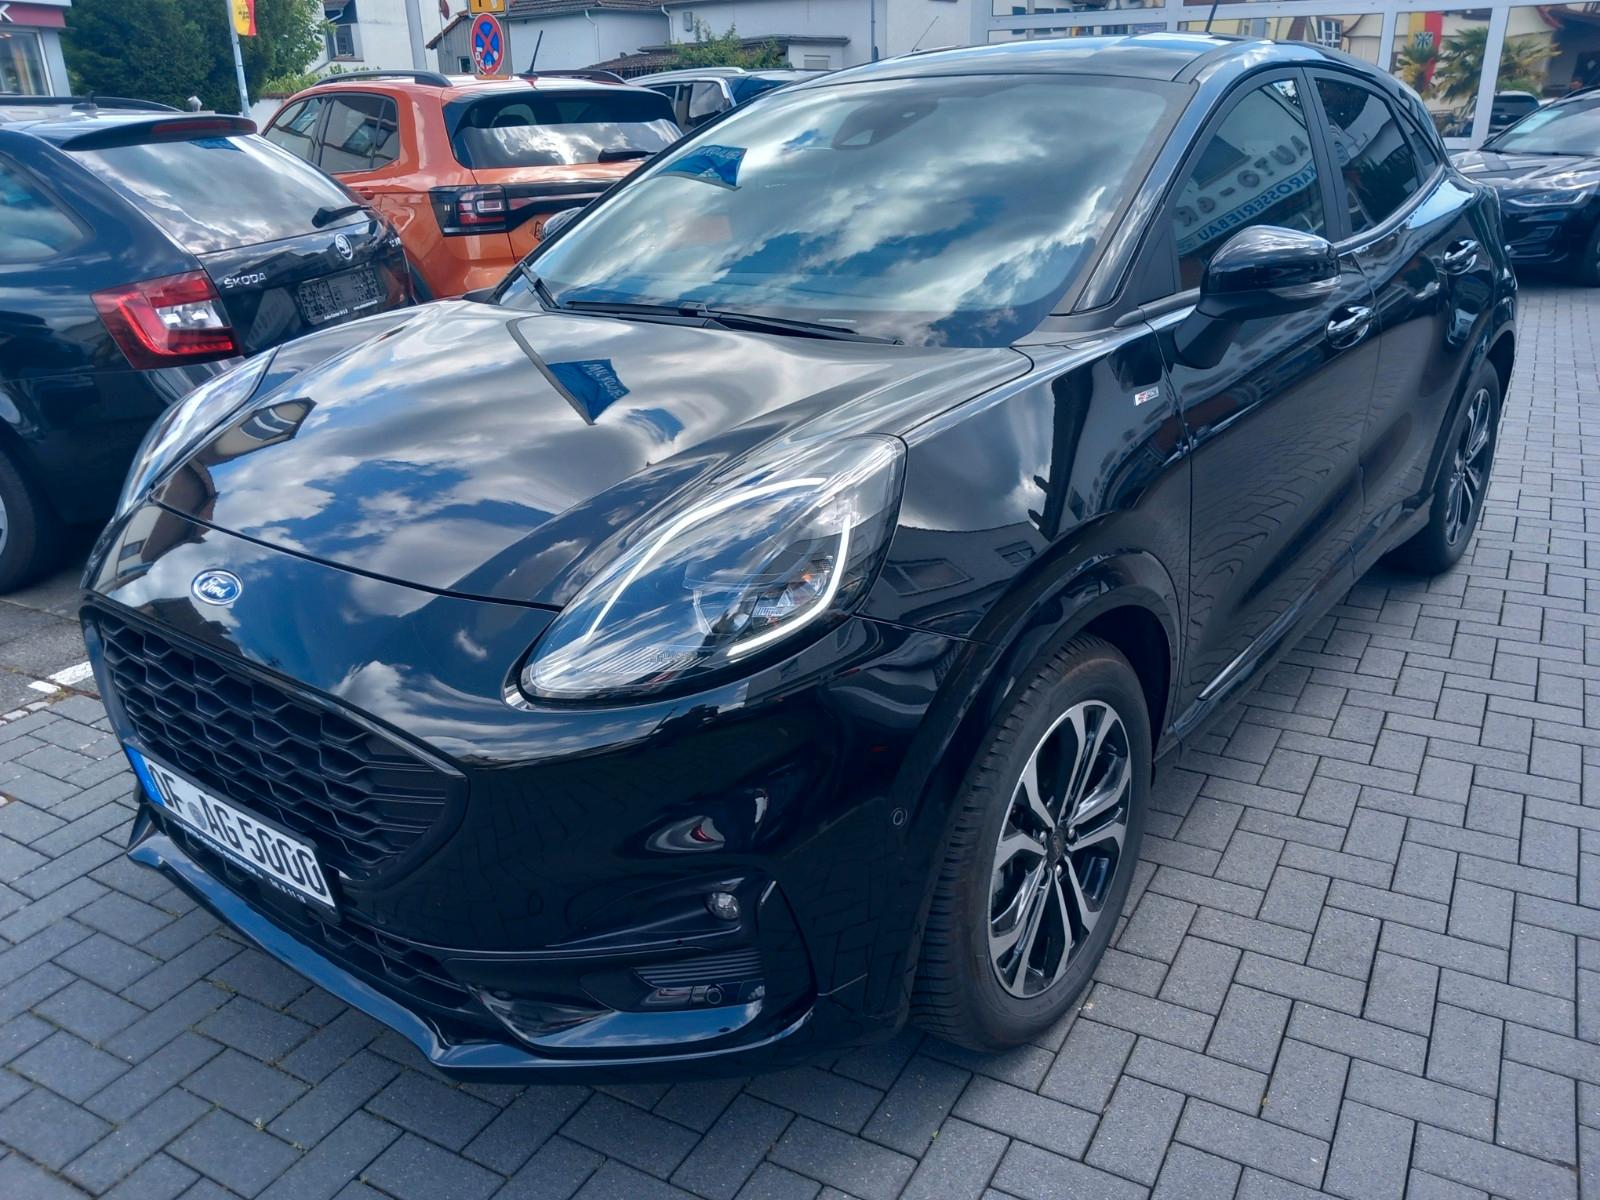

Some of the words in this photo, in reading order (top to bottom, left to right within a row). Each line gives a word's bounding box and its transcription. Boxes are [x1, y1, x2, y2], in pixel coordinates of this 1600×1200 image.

[223, 272, 268, 289] ŠKODA
[148, 764, 184, 814] OF
[199, 794, 244, 852] AG
[236, 816, 327, 897] 5000
